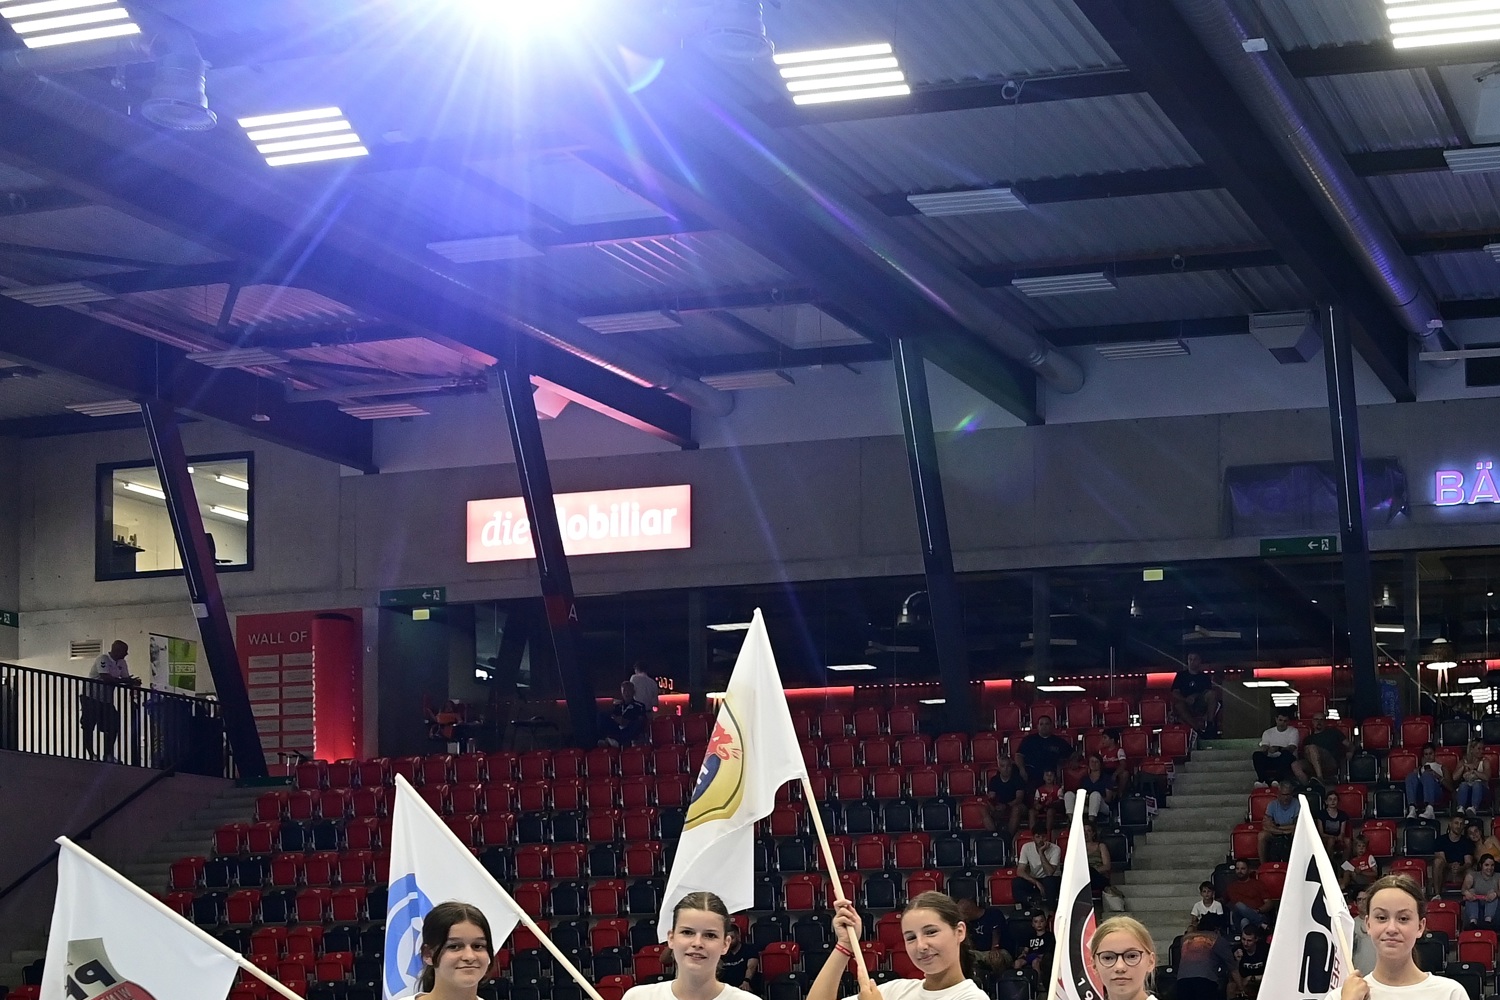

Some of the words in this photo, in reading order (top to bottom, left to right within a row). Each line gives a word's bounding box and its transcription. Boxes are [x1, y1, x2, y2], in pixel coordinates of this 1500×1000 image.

[568, 603, 578, 621] A
[248, 632, 285, 645] WALL
[289, 630, 308, 642] OF
[1030, 938, 1045, 948] USA
